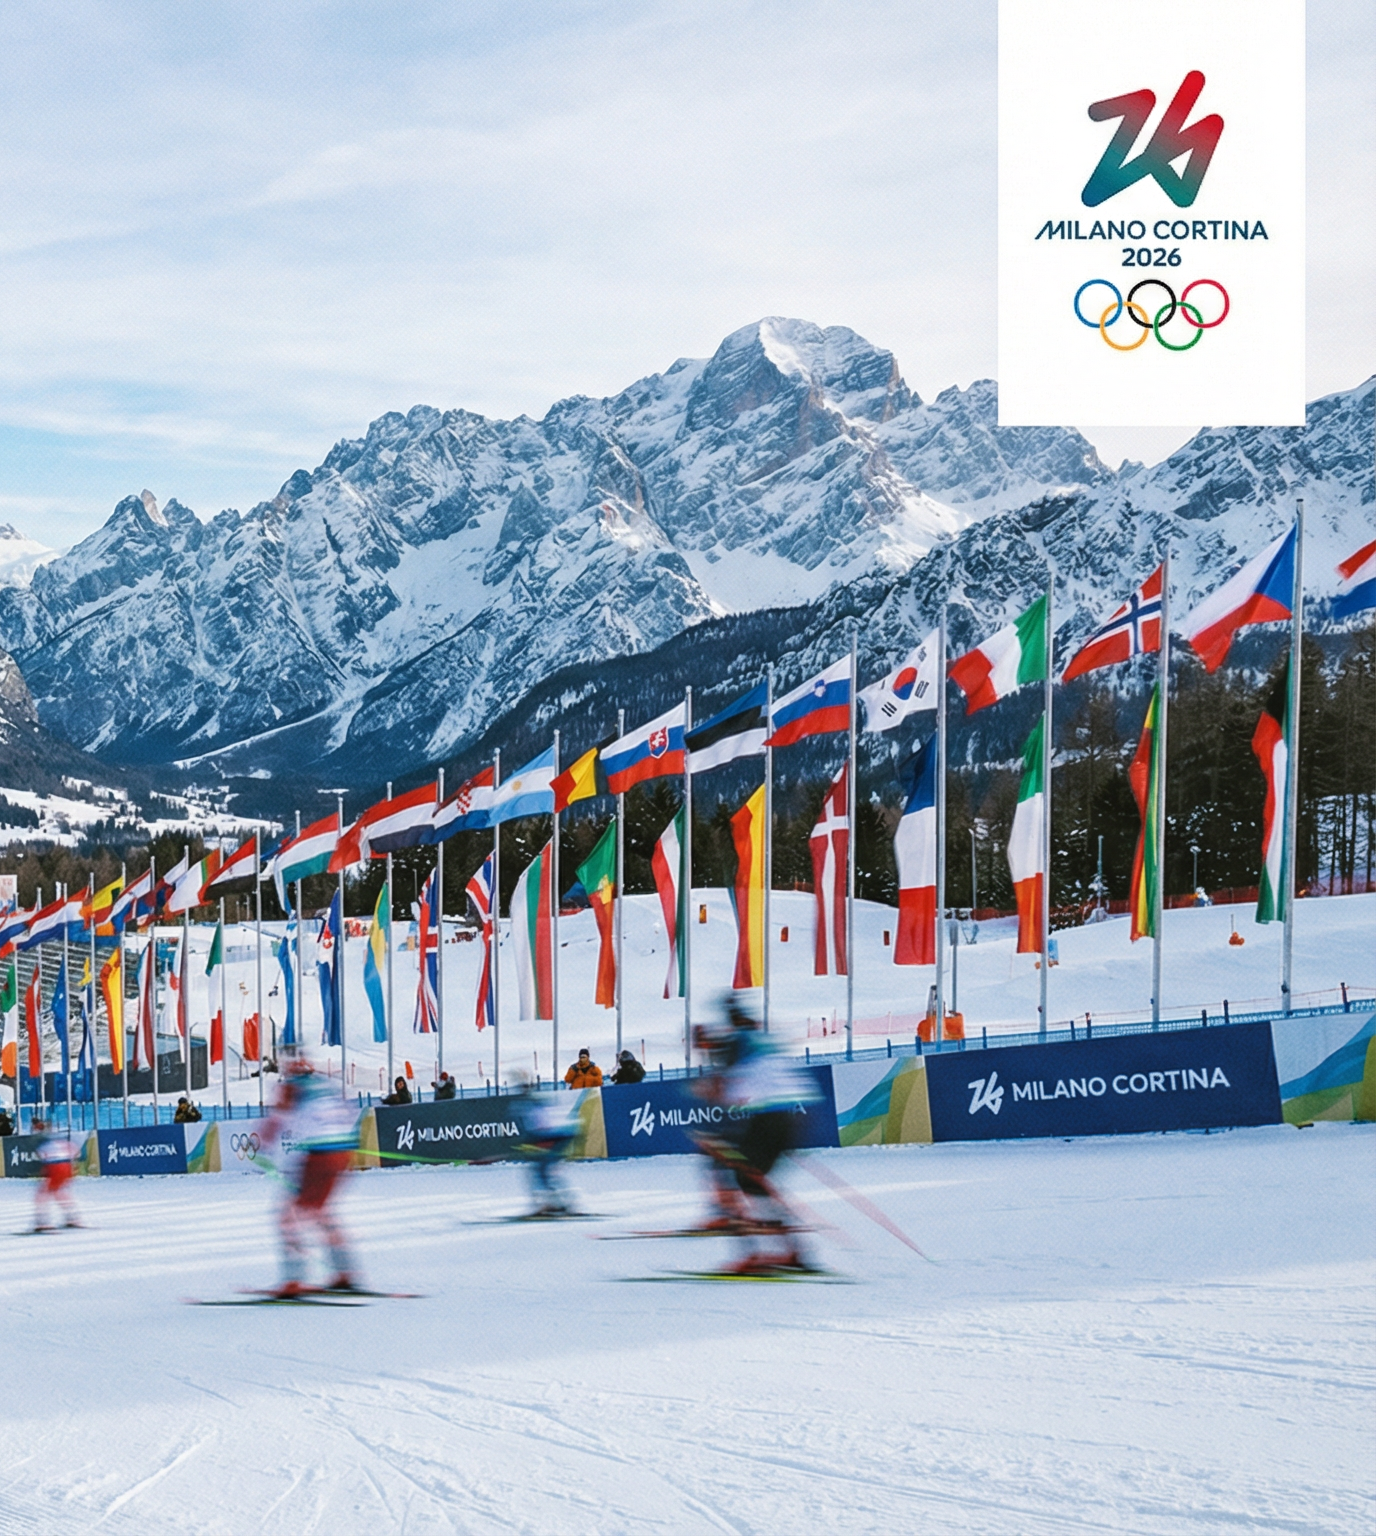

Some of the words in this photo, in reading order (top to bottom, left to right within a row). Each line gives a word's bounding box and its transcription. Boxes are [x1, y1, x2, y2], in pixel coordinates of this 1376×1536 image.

[1012, 1076, 1107, 1102] MILANO
[1112, 1066, 1231, 1095] CORTINA
[659, 1105, 724, 1127] MILANO
[417, 1124, 464, 1142] MILANO
[464, 1121, 520, 1139] CORTINA
